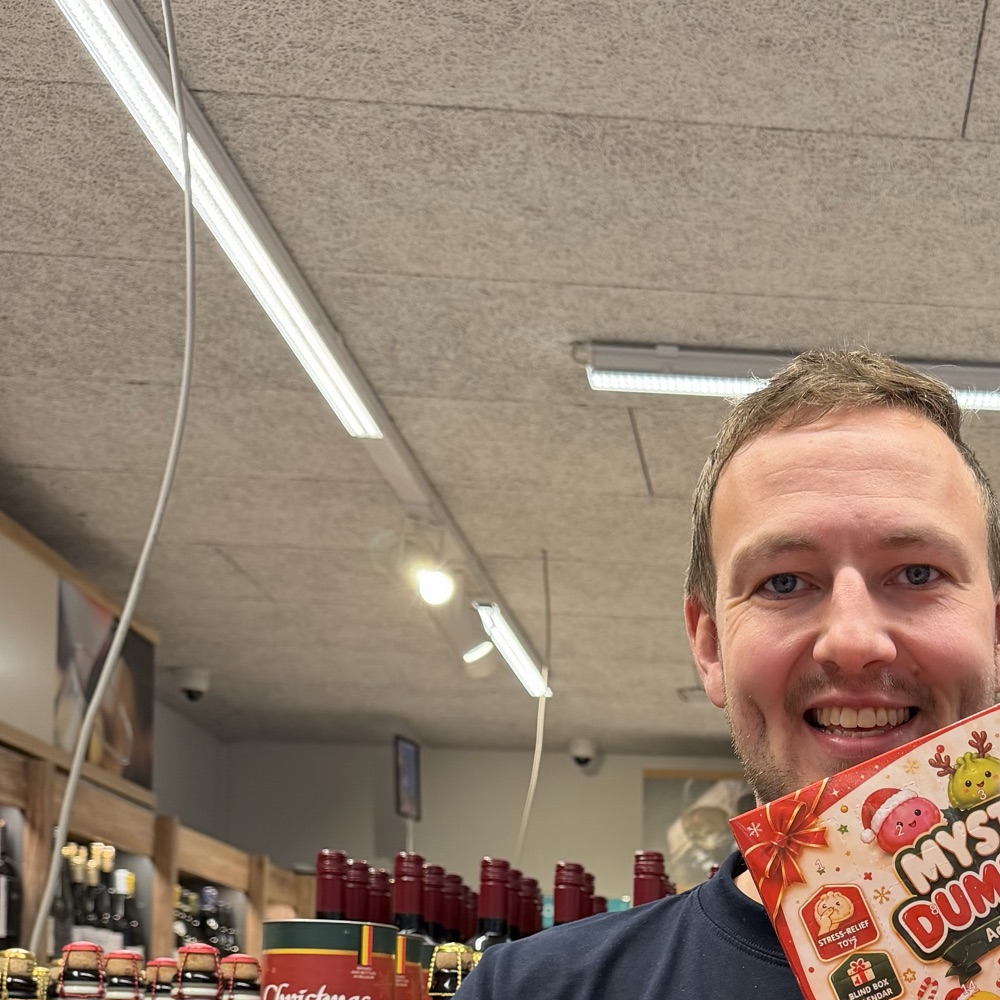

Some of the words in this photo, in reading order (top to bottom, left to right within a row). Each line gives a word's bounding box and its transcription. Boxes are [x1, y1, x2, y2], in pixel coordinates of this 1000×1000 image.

[977, 789, 988, 801] 3
[896, 823, 905, 837] 2
[817, 919, 870, 947] STRESS-RELIEF
[848, 985, 872, 1000] BLIND
[873, 978, 889, 991] BOX
[960, 979, 978, 996] 14
